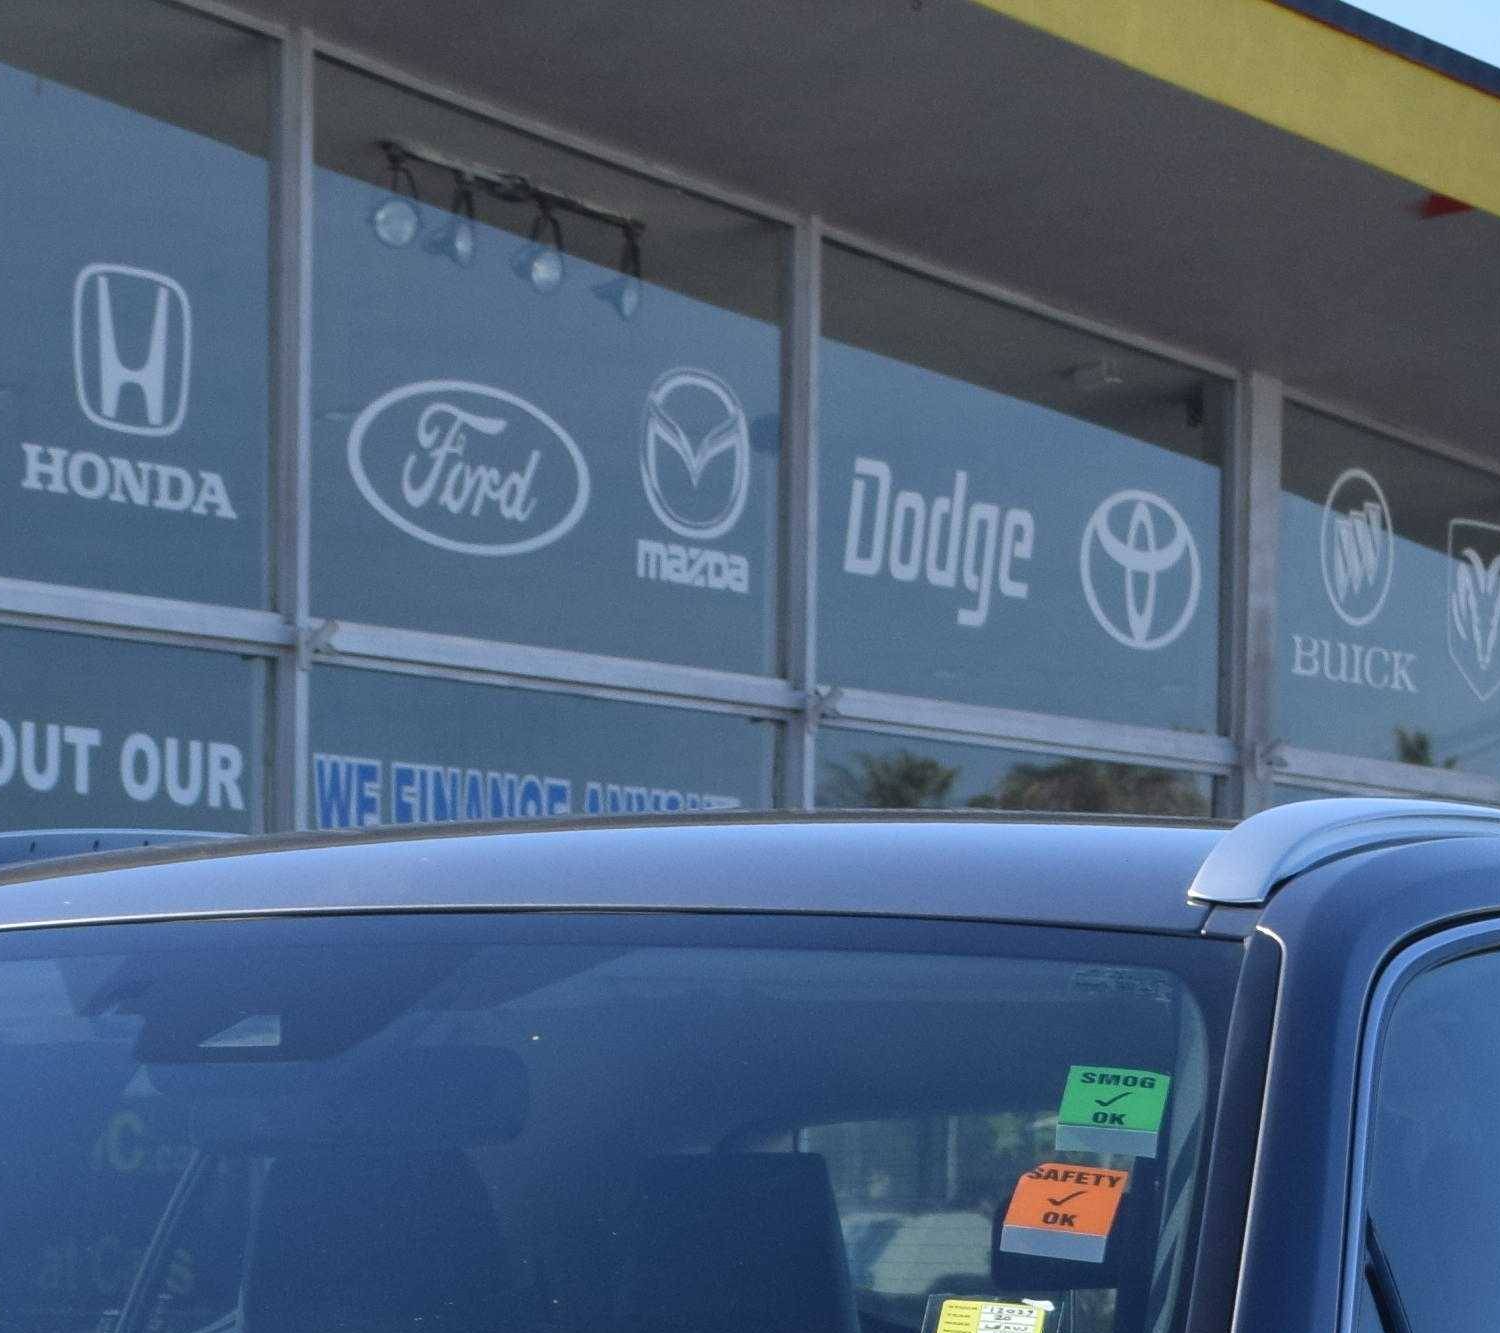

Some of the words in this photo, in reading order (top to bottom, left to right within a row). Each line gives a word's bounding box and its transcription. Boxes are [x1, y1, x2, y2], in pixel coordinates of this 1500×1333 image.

[21, 441, 237, 520] HONDA
[402, 402, 540, 524] Ford
[843, 457, 1035, 628] Dodge
[1290, 634, 1420, 693] BUICK
[120, 733, 245, 811] OUR
[1080, 1071, 1157, 1089] SMOG
[1091, 1111, 1128, 1126] OK
[1027, 1167, 1122, 1188] SAFETY
[1041, 1210, 1078, 1228] OK
